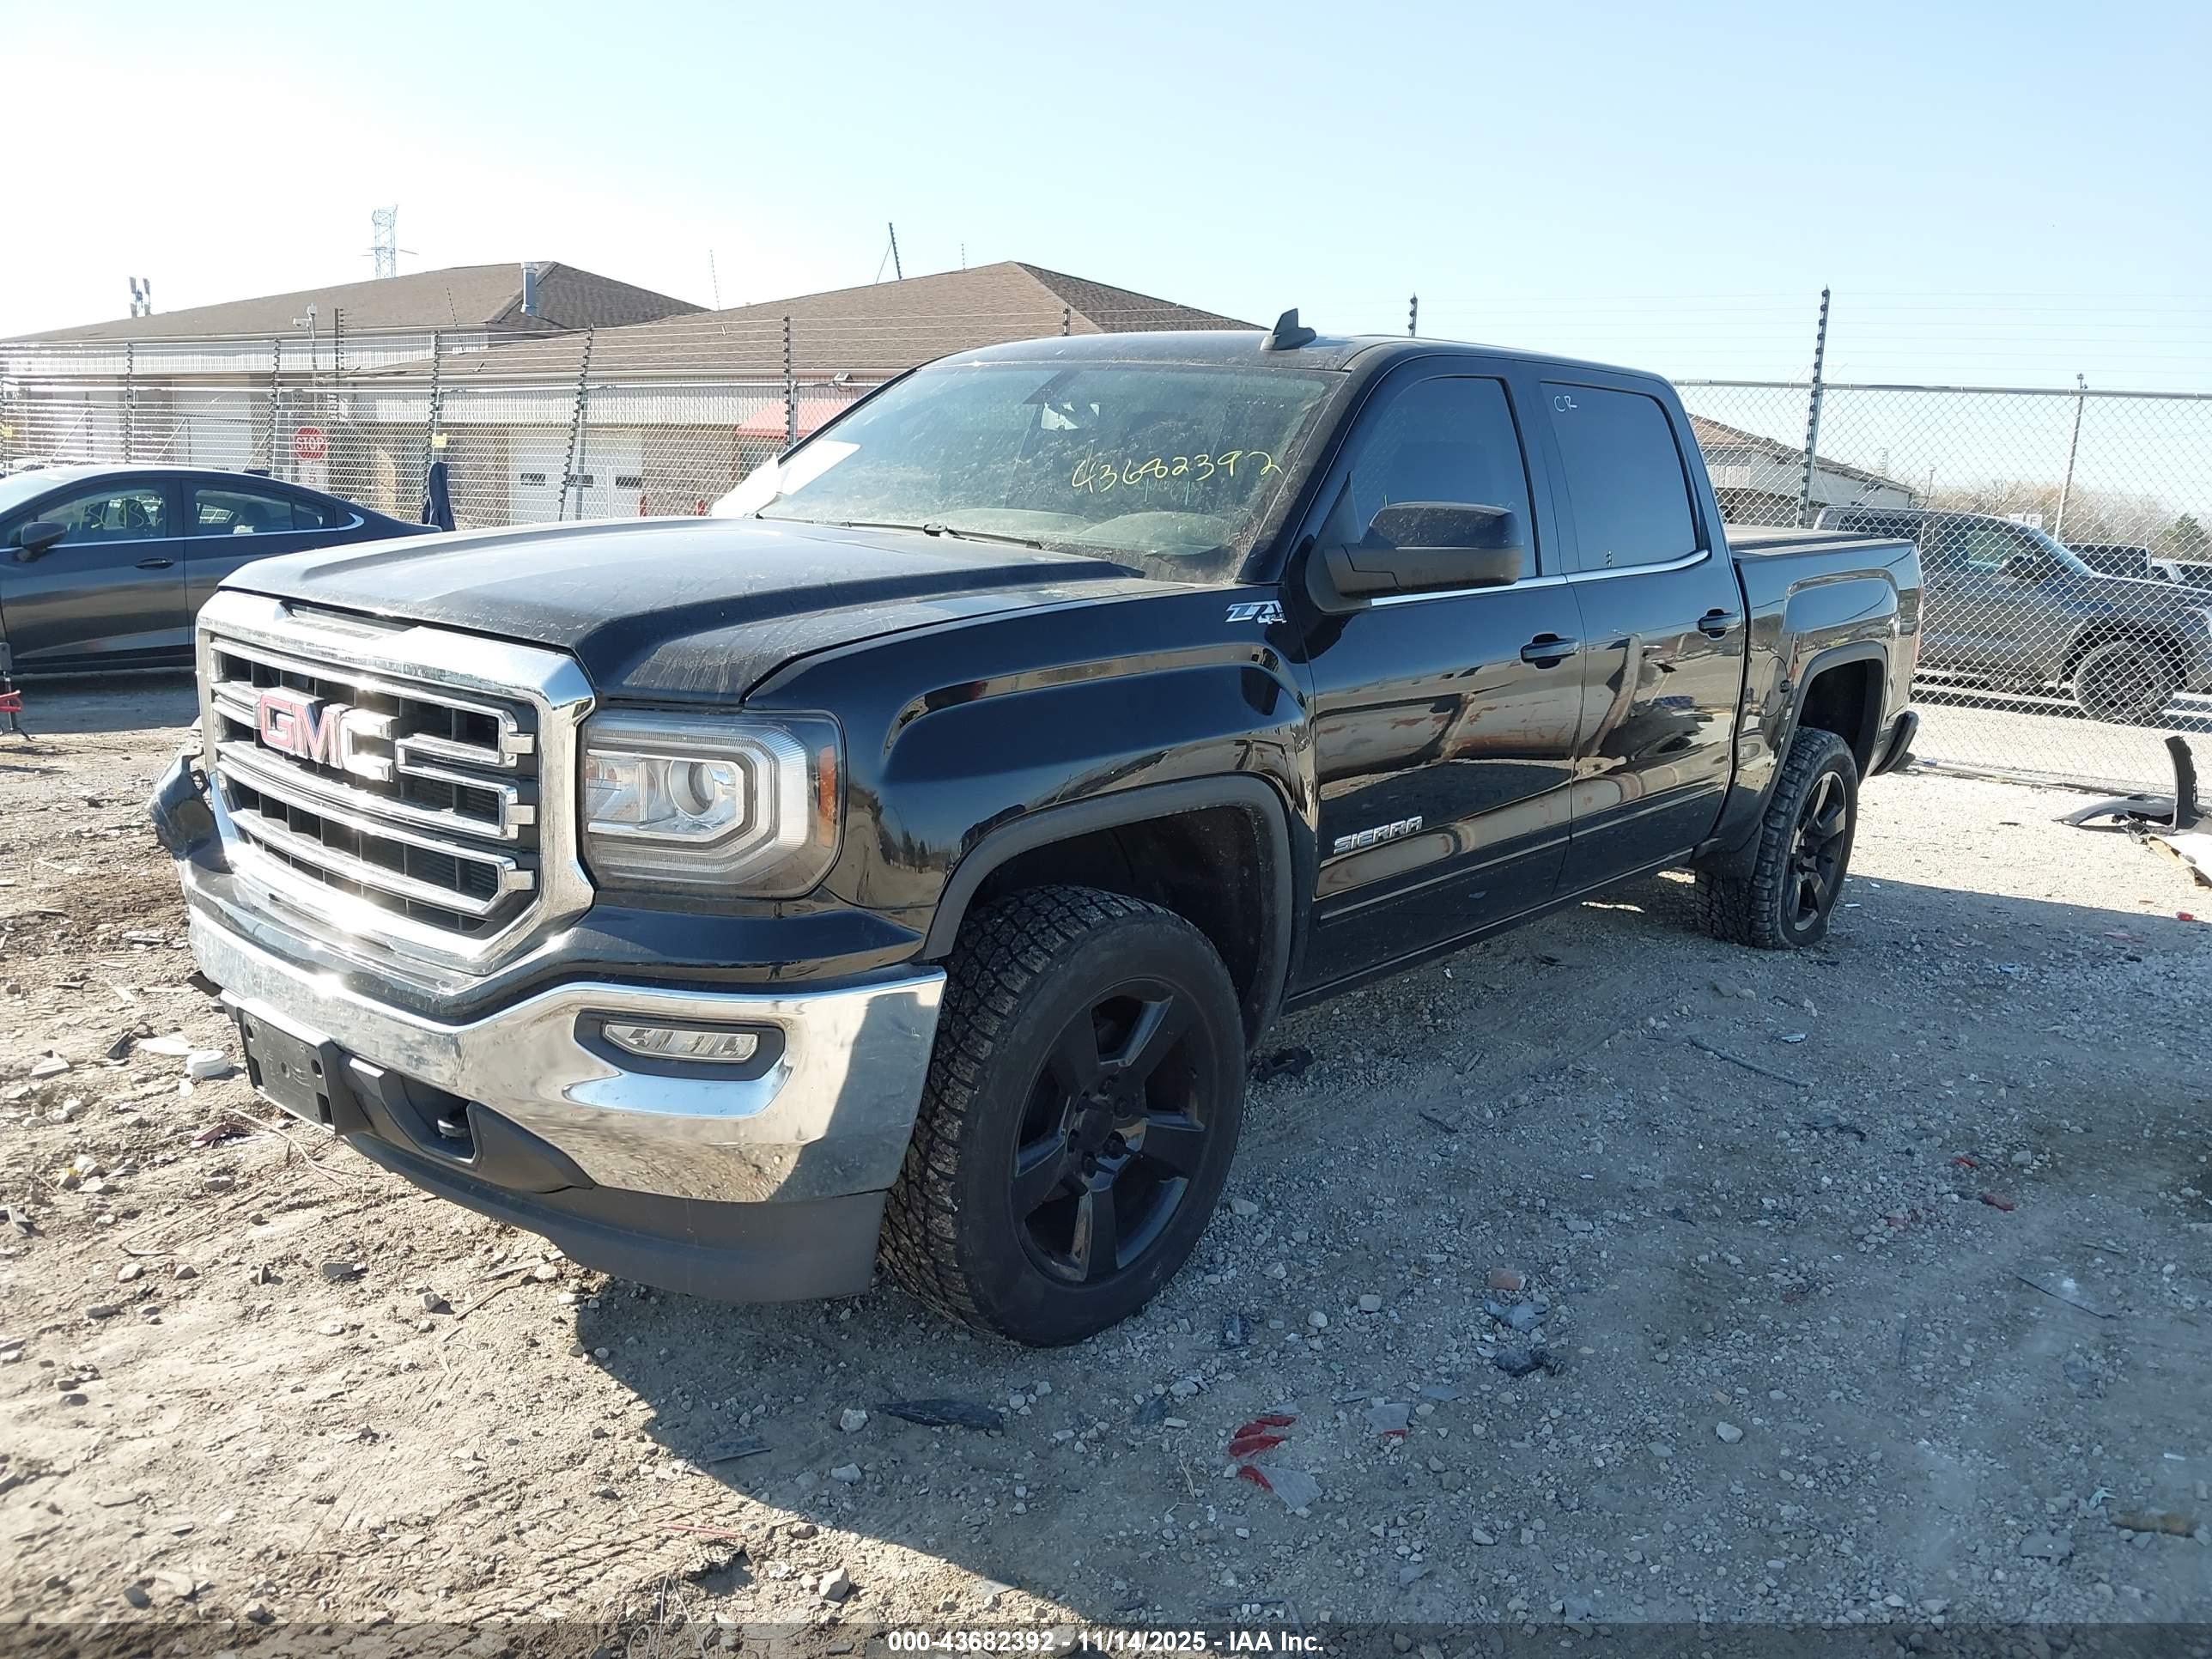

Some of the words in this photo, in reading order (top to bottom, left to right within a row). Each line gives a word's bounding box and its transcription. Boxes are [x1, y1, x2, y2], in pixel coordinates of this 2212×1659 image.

[295, 436, 324, 450] STOP
[1071, 450, 1284, 494] 43682392
[1225, 600, 1286, 624] Z71
[260, 692, 393, 781] GMC
[1334, 816, 1423, 854] SIERRA
